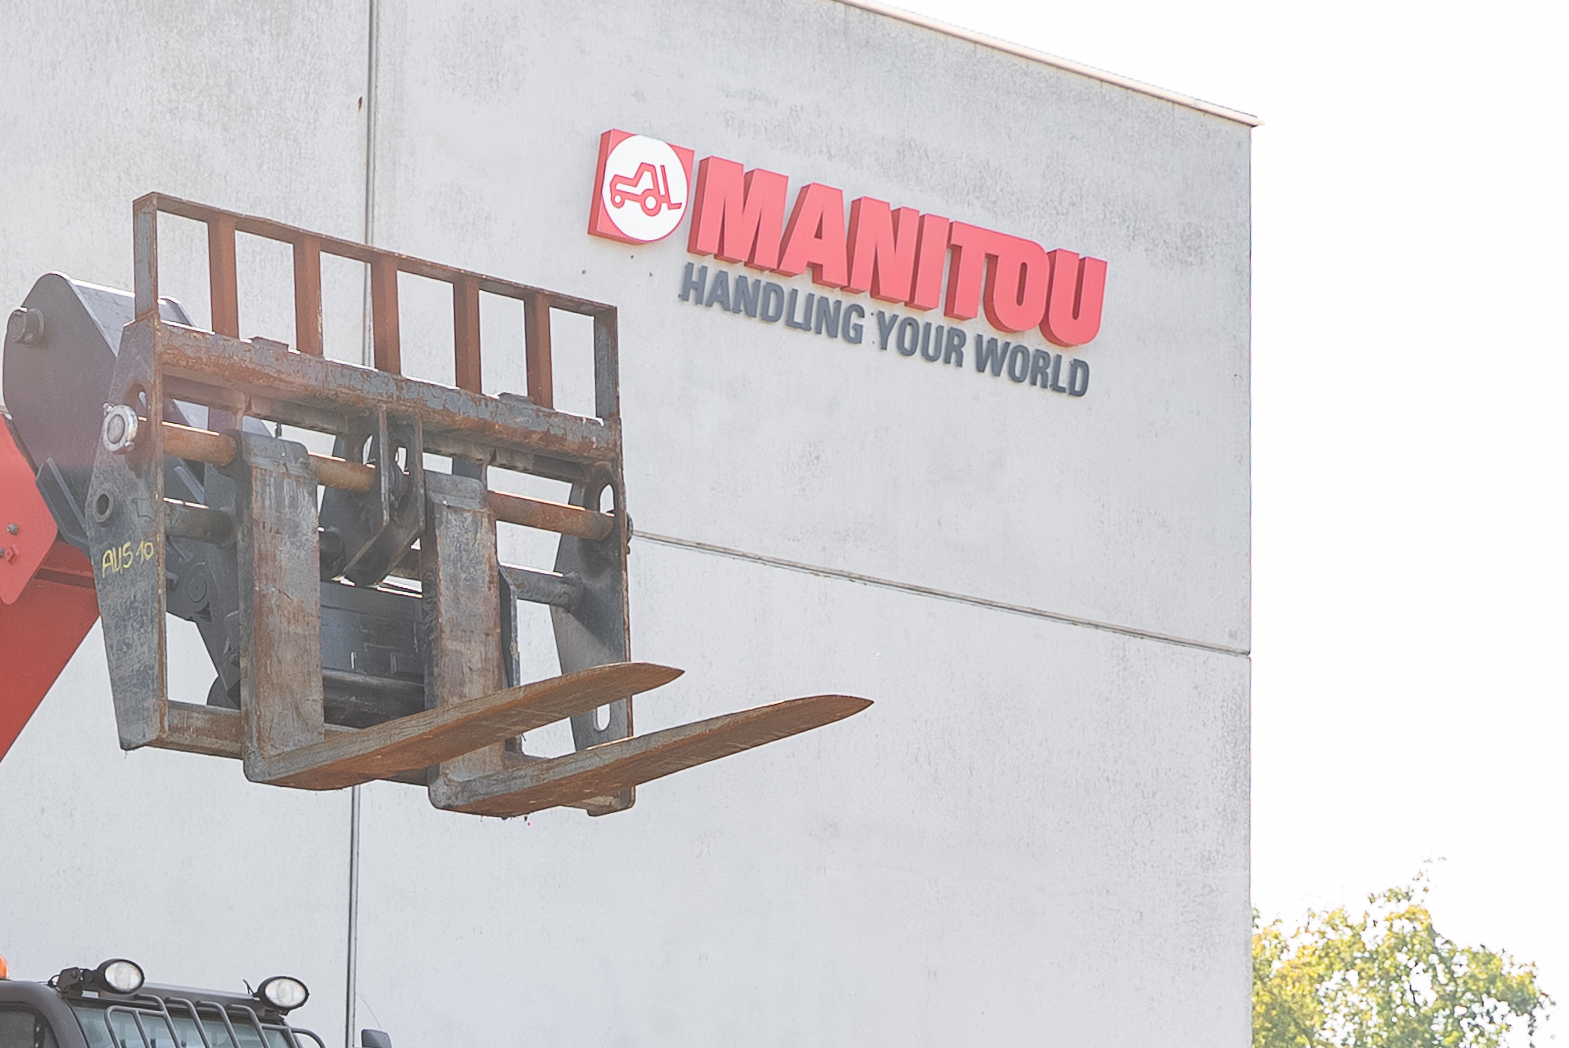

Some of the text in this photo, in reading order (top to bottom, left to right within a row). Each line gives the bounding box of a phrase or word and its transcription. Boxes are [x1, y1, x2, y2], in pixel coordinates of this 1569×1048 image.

[681, 262, 1091, 398] HANDLING YOUR WORLD
[687, 156, 1108, 347] MANITOU
